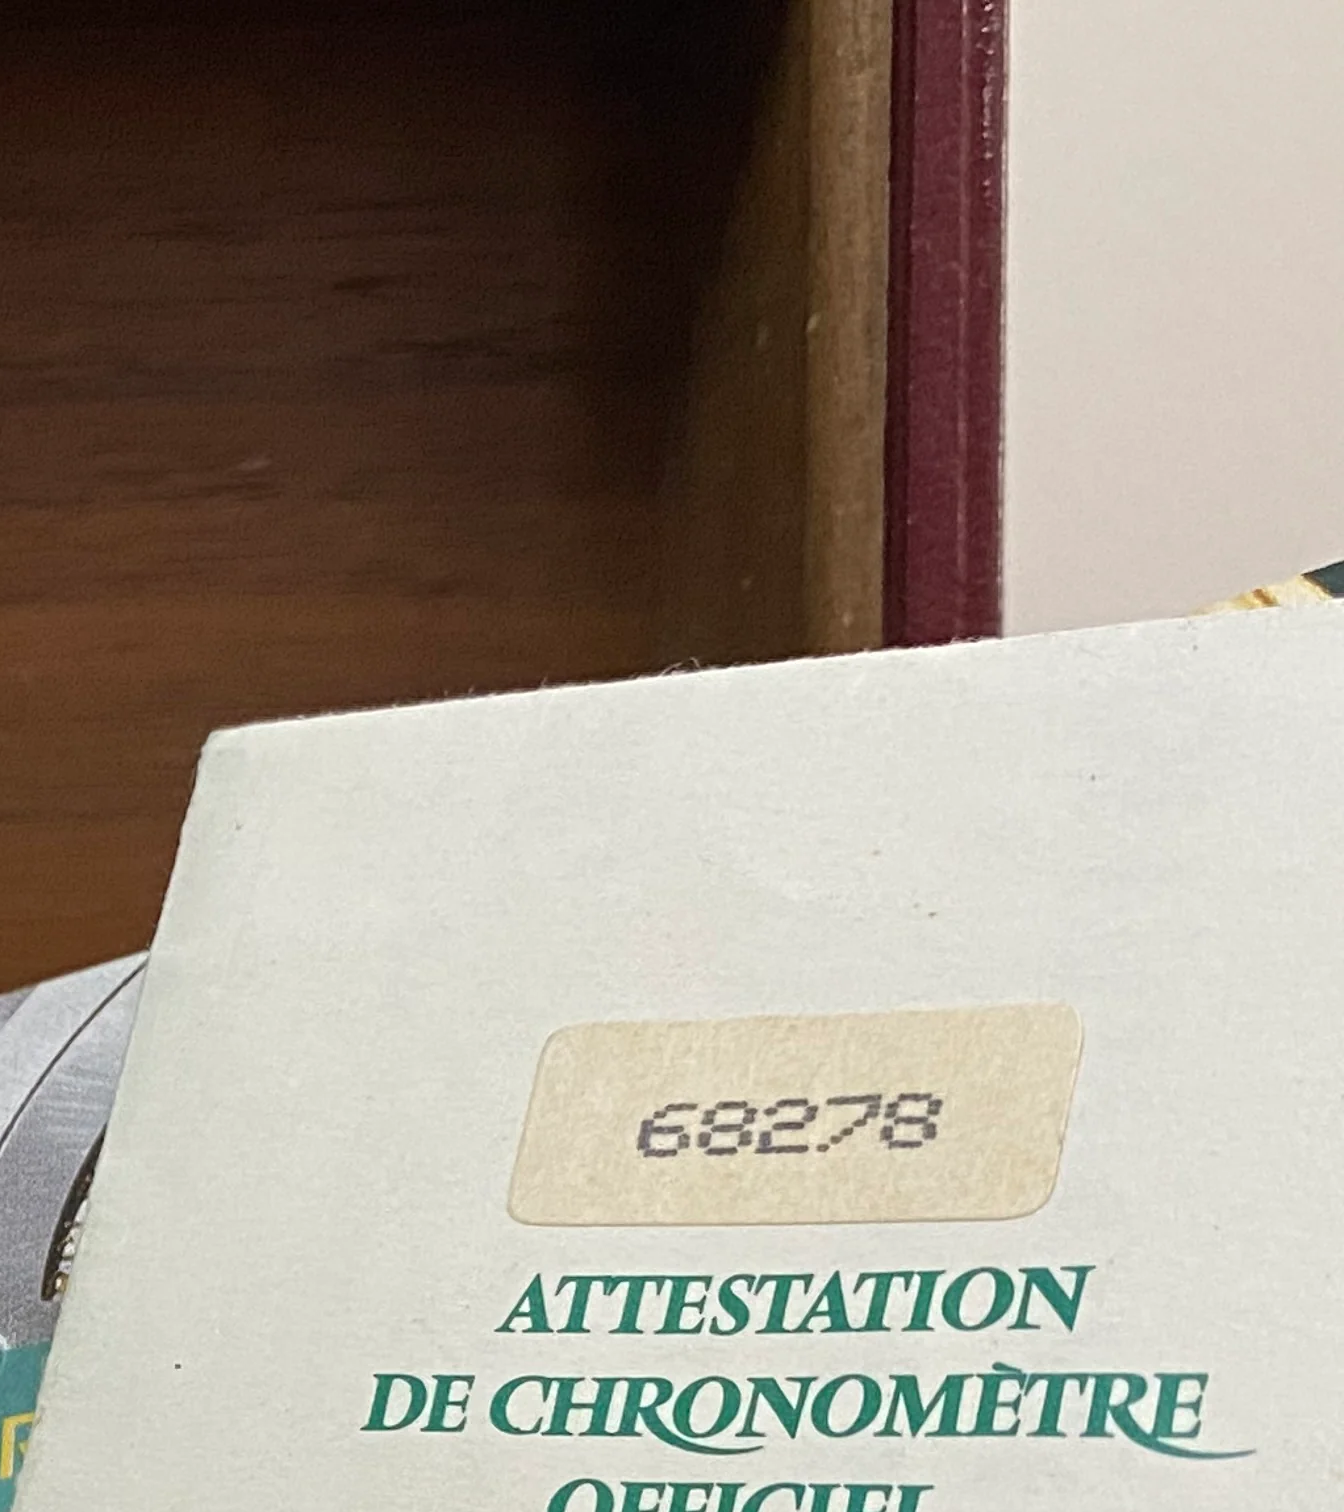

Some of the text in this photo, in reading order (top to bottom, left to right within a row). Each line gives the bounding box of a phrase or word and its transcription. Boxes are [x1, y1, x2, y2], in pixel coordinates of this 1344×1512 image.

[635, 1092, 944, 1158] 68278
[496, 1264, 1096, 1336] ATTESTATION
[360, 1362, 1258, 1460] DE CHRONOMÈTRE
